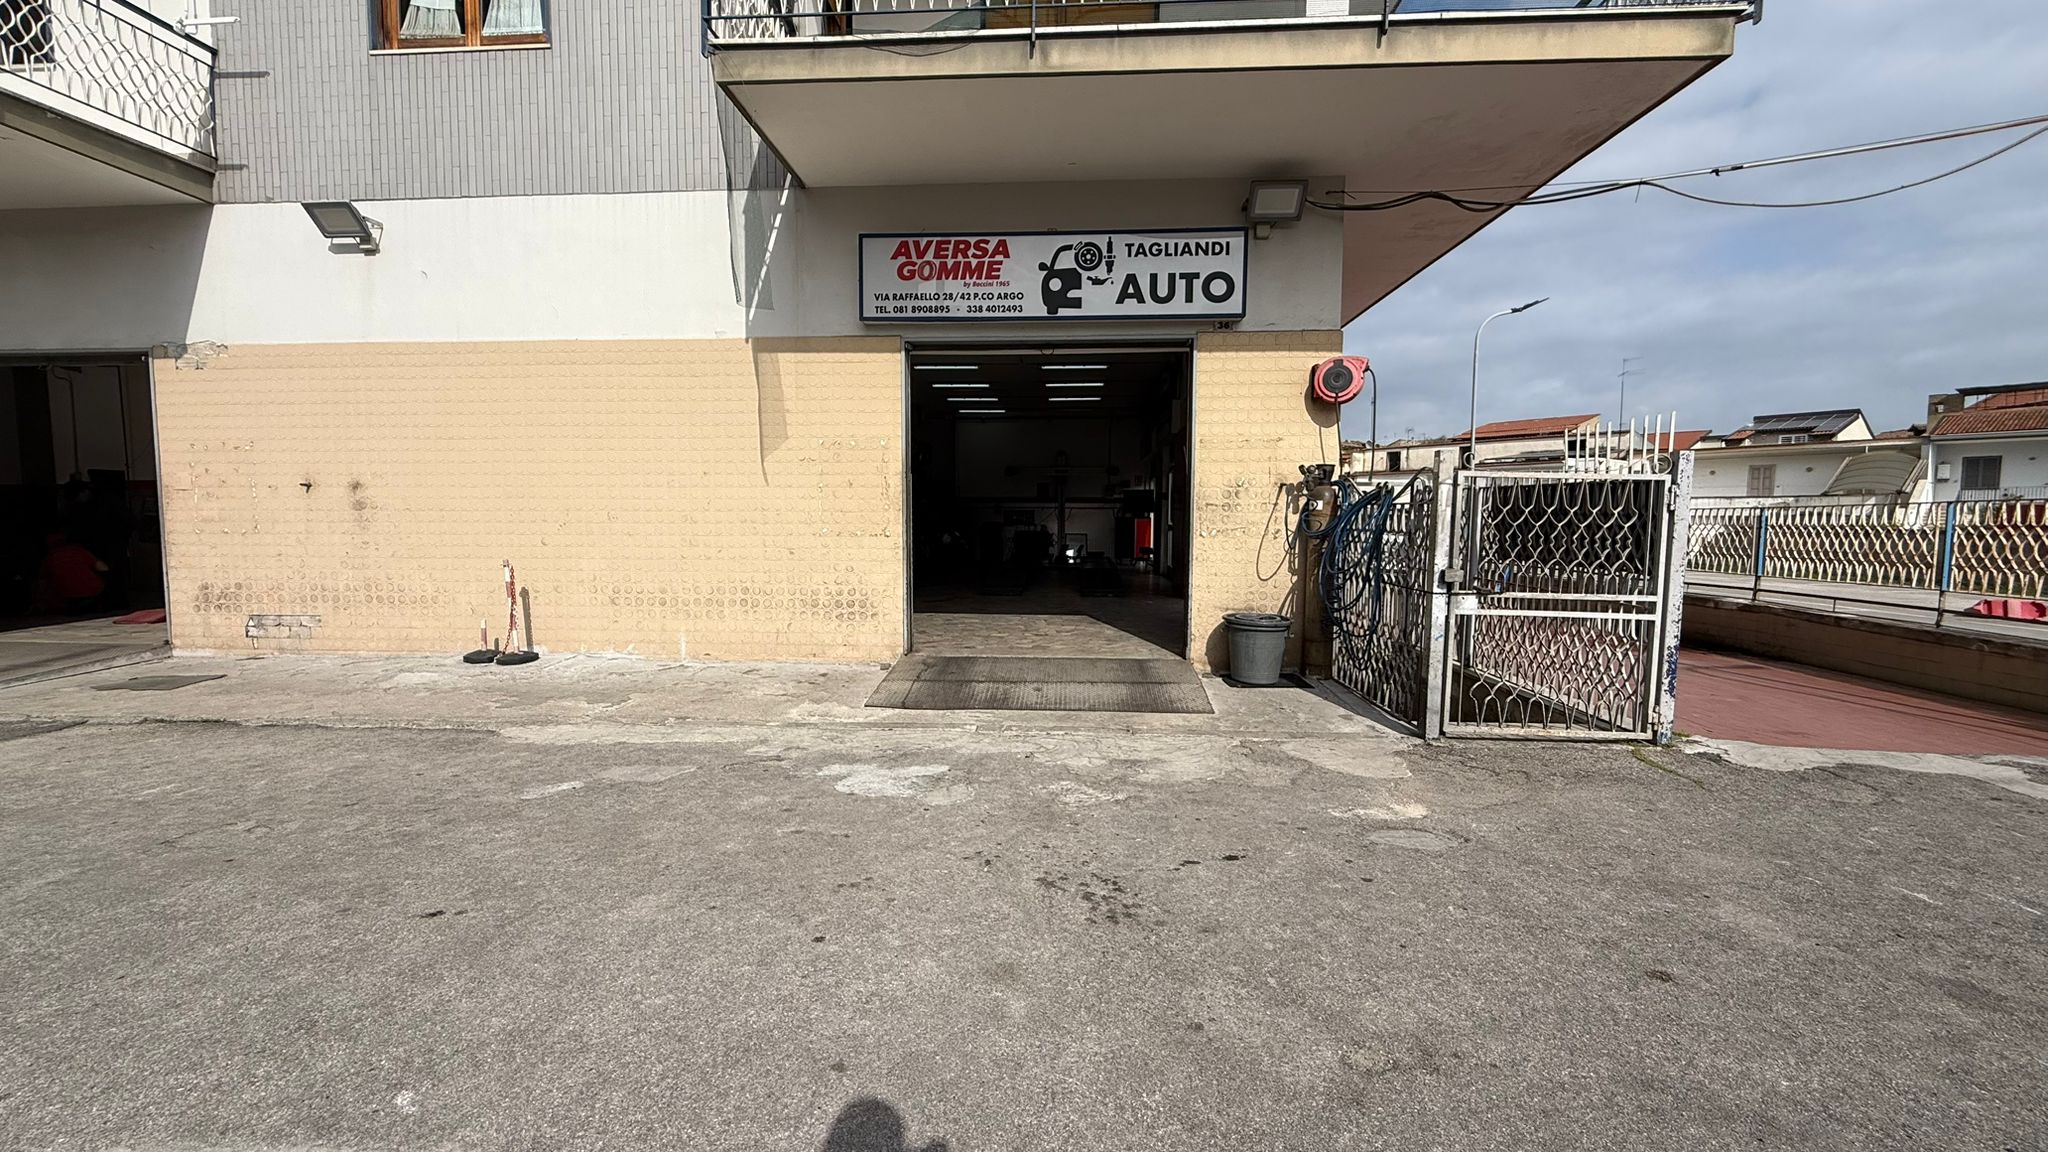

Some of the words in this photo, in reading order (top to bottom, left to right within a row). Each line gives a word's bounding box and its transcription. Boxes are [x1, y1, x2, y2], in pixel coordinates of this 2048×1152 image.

[890, 239, 1011, 260] AVERSA
[1125, 241, 1231, 258] TAGLIANDI
[896, 260, 1004, 281] GOMME
[963, 281, 971, 289] by
[995, 280, 1010, 288] 1965
[1115, 270, 1236, 305] AUTO
[874, 293, 890, 301] VIA
[892, 292, 941, 301] RAFFAELLO
[942, 292, 971, 303] 28/42
[973, 292, 994, 301] P.CO
[996, 291, 1024, 301] ARGO
[874, 305, 891, 314] TEL.
[893, 305, 908, 314] 081
[911, 305, 950, 313] 8908895
[966, 305, 983, 313] 338
[985, 304, 1023, 313] 4012493
